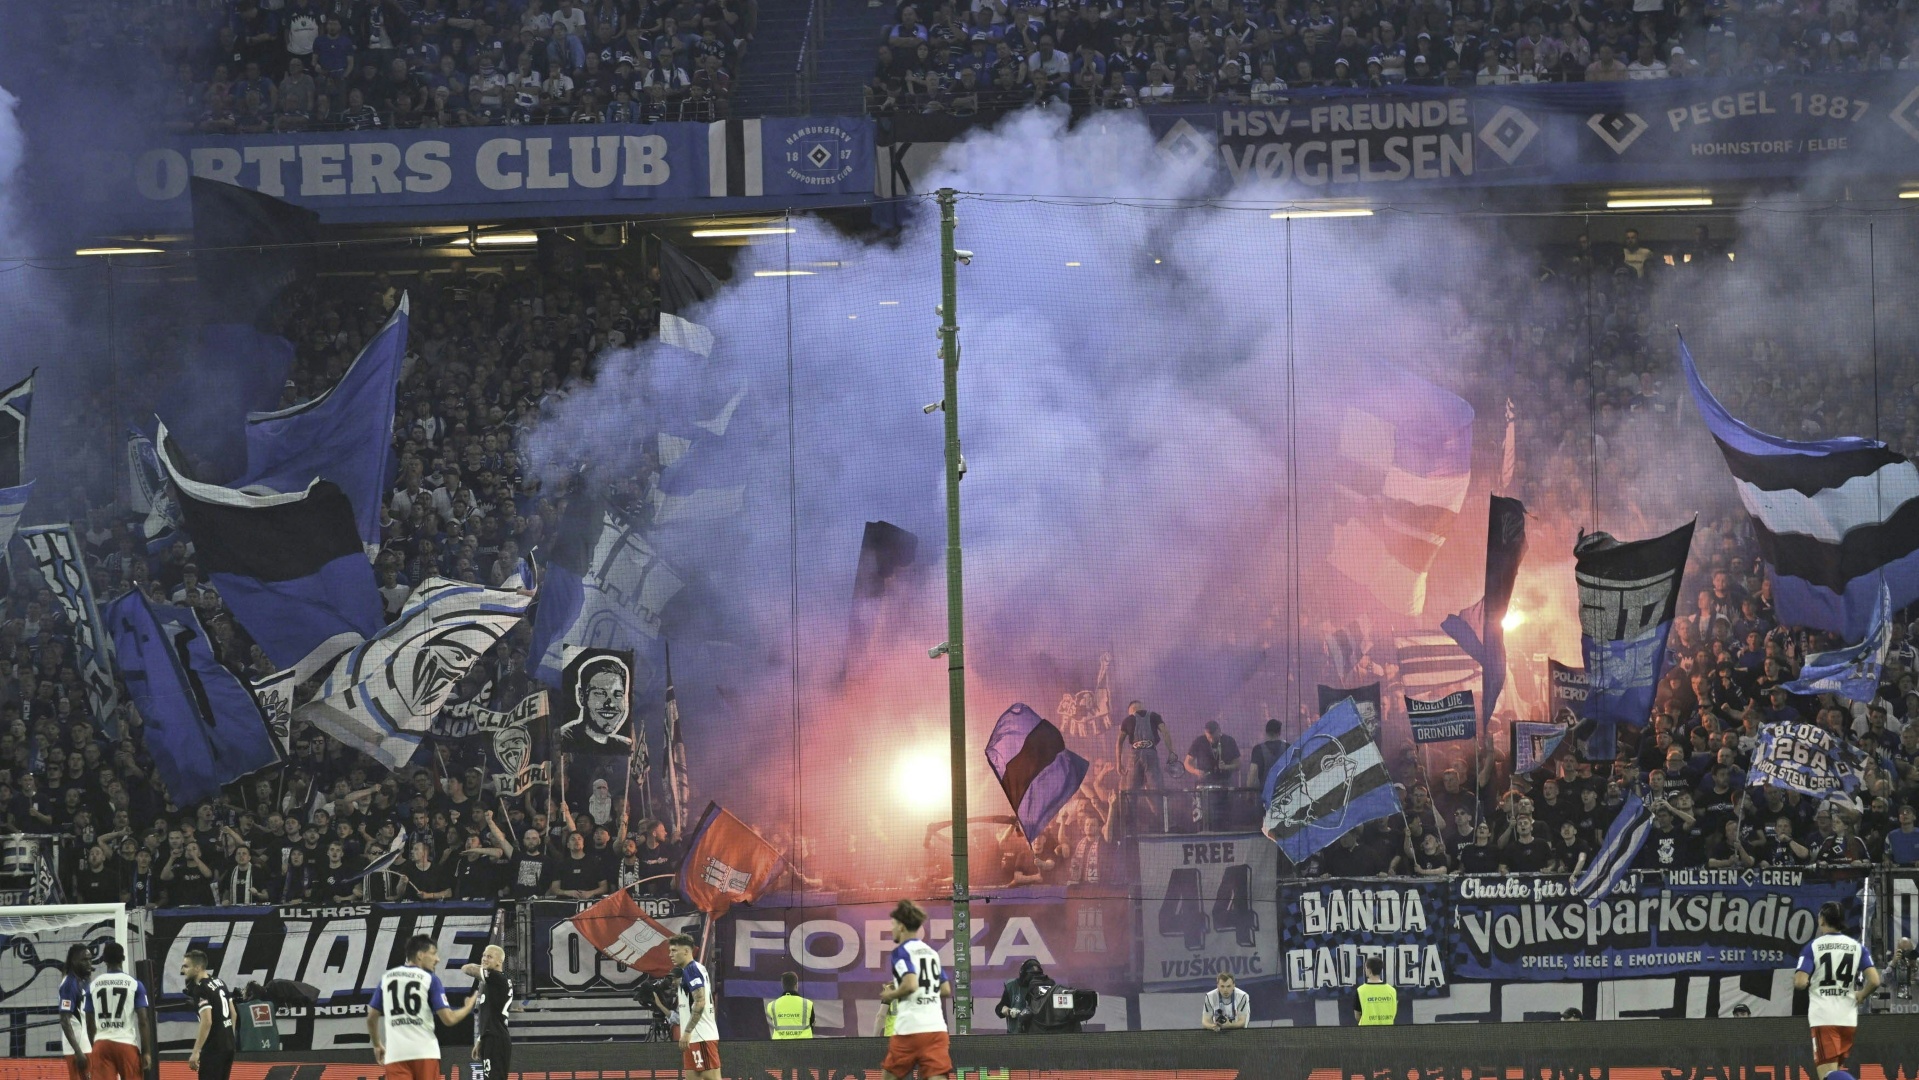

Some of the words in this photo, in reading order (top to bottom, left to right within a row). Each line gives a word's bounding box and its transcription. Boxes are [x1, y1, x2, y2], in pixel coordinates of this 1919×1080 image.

[1222, 99, 1468, 137] HSV-FREUNDE
[1667, 90, 1776, 133] PEGEL
[1791, 92, 1870, 122] 1887
[786, 152, 799, 162] 18
[840, 149, 852, 160] 87
[1220, 132, 1474, 186] VØGELSEN
[1691, 140, 1794, 156] HOHNSTORF
[1808, 138, 1848, 150] ELBE
[475, 134, 671, 190] CLUB
[786, 167, 836, 185] SUPPORTERS
[1411, 699, 1444, 711] GEGEN
[1447, 693, 1463, 707] DIE
[1417, 724, 1465, 740] ORDNUNG
[1775, 737, 1828, 771] 26A
[1809, 776, 1841, 788] CREW
[1182, 842, 1235, 865] FREE
[1460, 876, 1531, 900] Charlie
[1533, 878, 1568, 903] für
[1669, 870, 1738, 886] HOLSTEN
[1762, 870, 1803, 886] CREW
[279, 905, 372, 918] ULTRAS
[1158, 863, 1259, 951] 44
[1300, 888, 1427, 935] BANDA
[1161, 952, 1263, 978] VUŠKOVIĆ
[1522, 956, 1567, 969] SPIELE,
[1573, 955, 1608, 968] SIEGE
[1614, 955, 1623, 967] &
[1629, 951, 1701, 966] EMOTIONEN
[1720, 950, 1745, 962] SEIT
[1752, 950, 1784, 962] 1953
[1819, 952, 1854, 988] 14
[919, 957, 940, 995] 49
[97, 987, 128, 1019] 17
[219, 989, 230, 1018] 6
[314, 1004, 369, 1016] NOR
[387, 980, 421, 1016] 16
